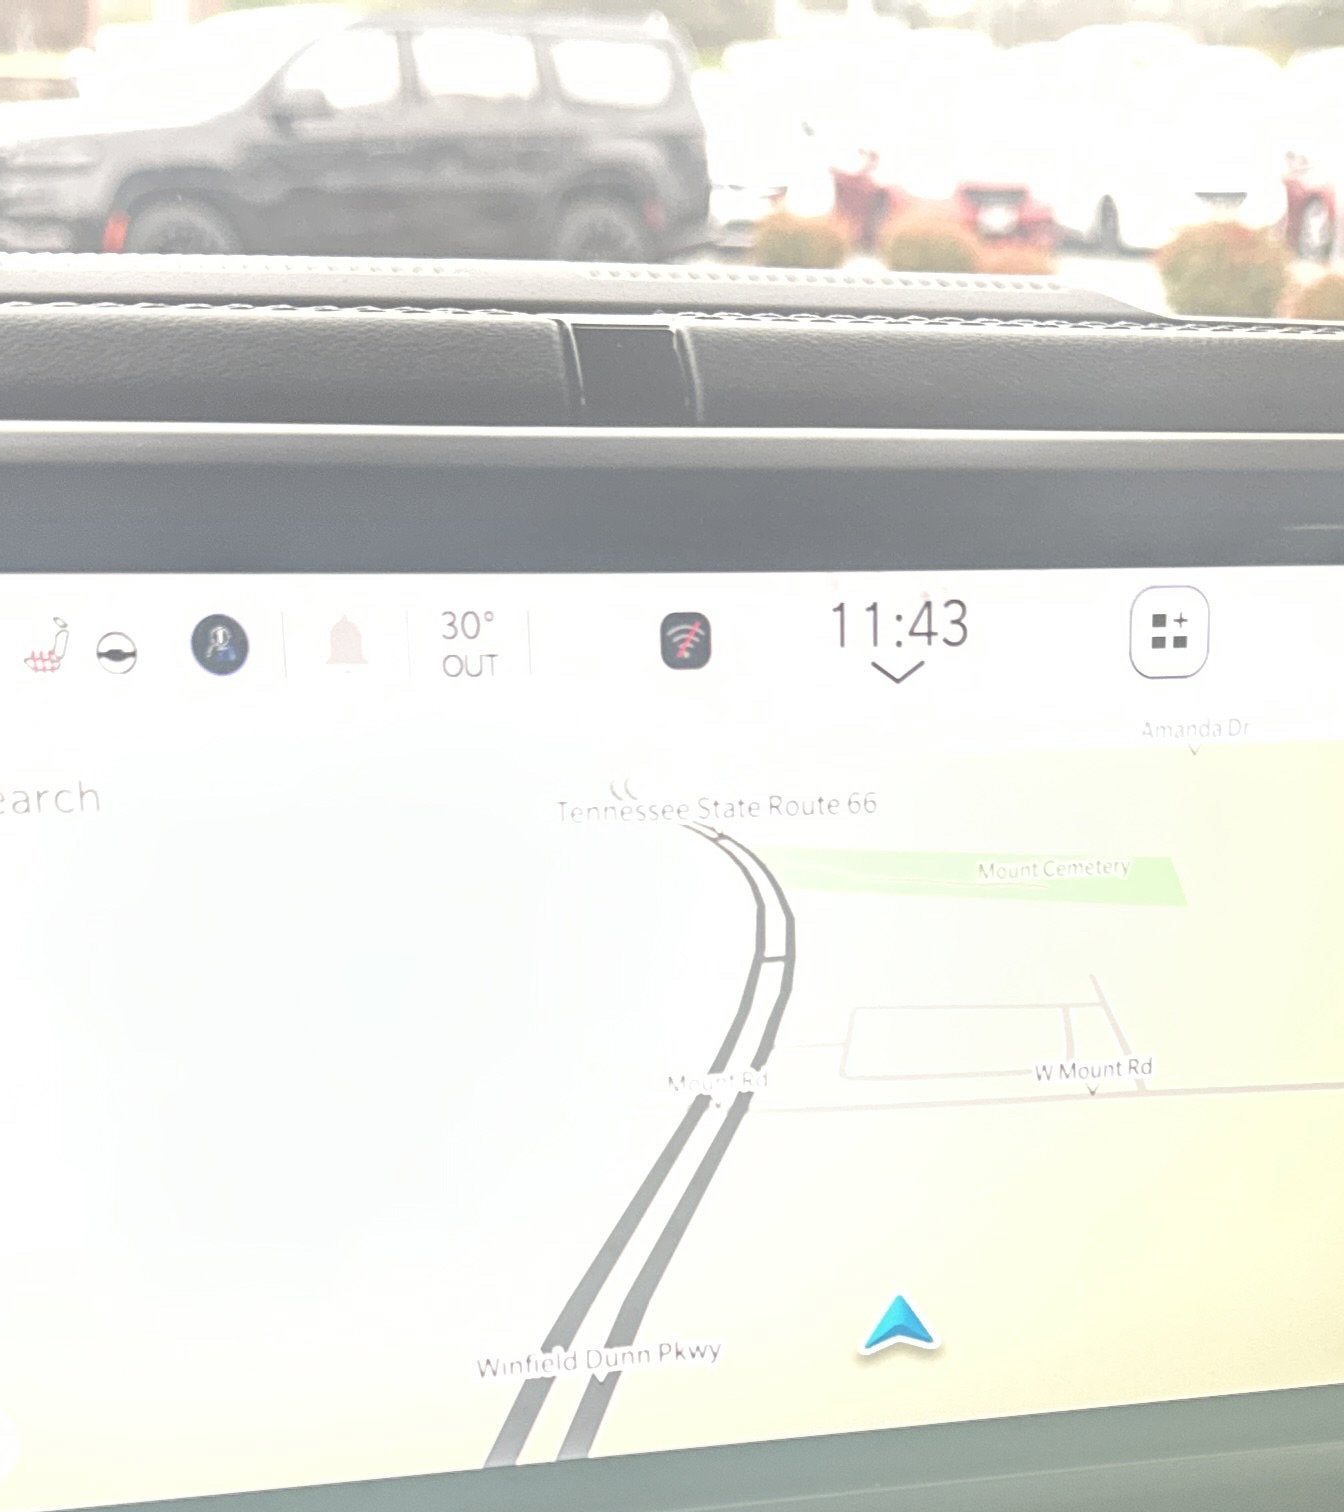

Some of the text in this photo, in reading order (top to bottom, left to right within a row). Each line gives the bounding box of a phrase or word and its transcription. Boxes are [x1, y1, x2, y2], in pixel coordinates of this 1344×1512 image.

[441, 610, 495, 640] 30°
[832, 598, 968, 648] 11:43
[442, 653, 499, 678] OUT
[1141, 717, 1250, 738] Amanda Dr
[557, 792, 877, 823] Tennessee State Route 66
[978, 860, 1131, 880] Mount Cemetery
[1034, 1057, 1153, 1080] W Mount Rd
[476, 1340, 722, 1379] Winfield Dunn Pkwy
